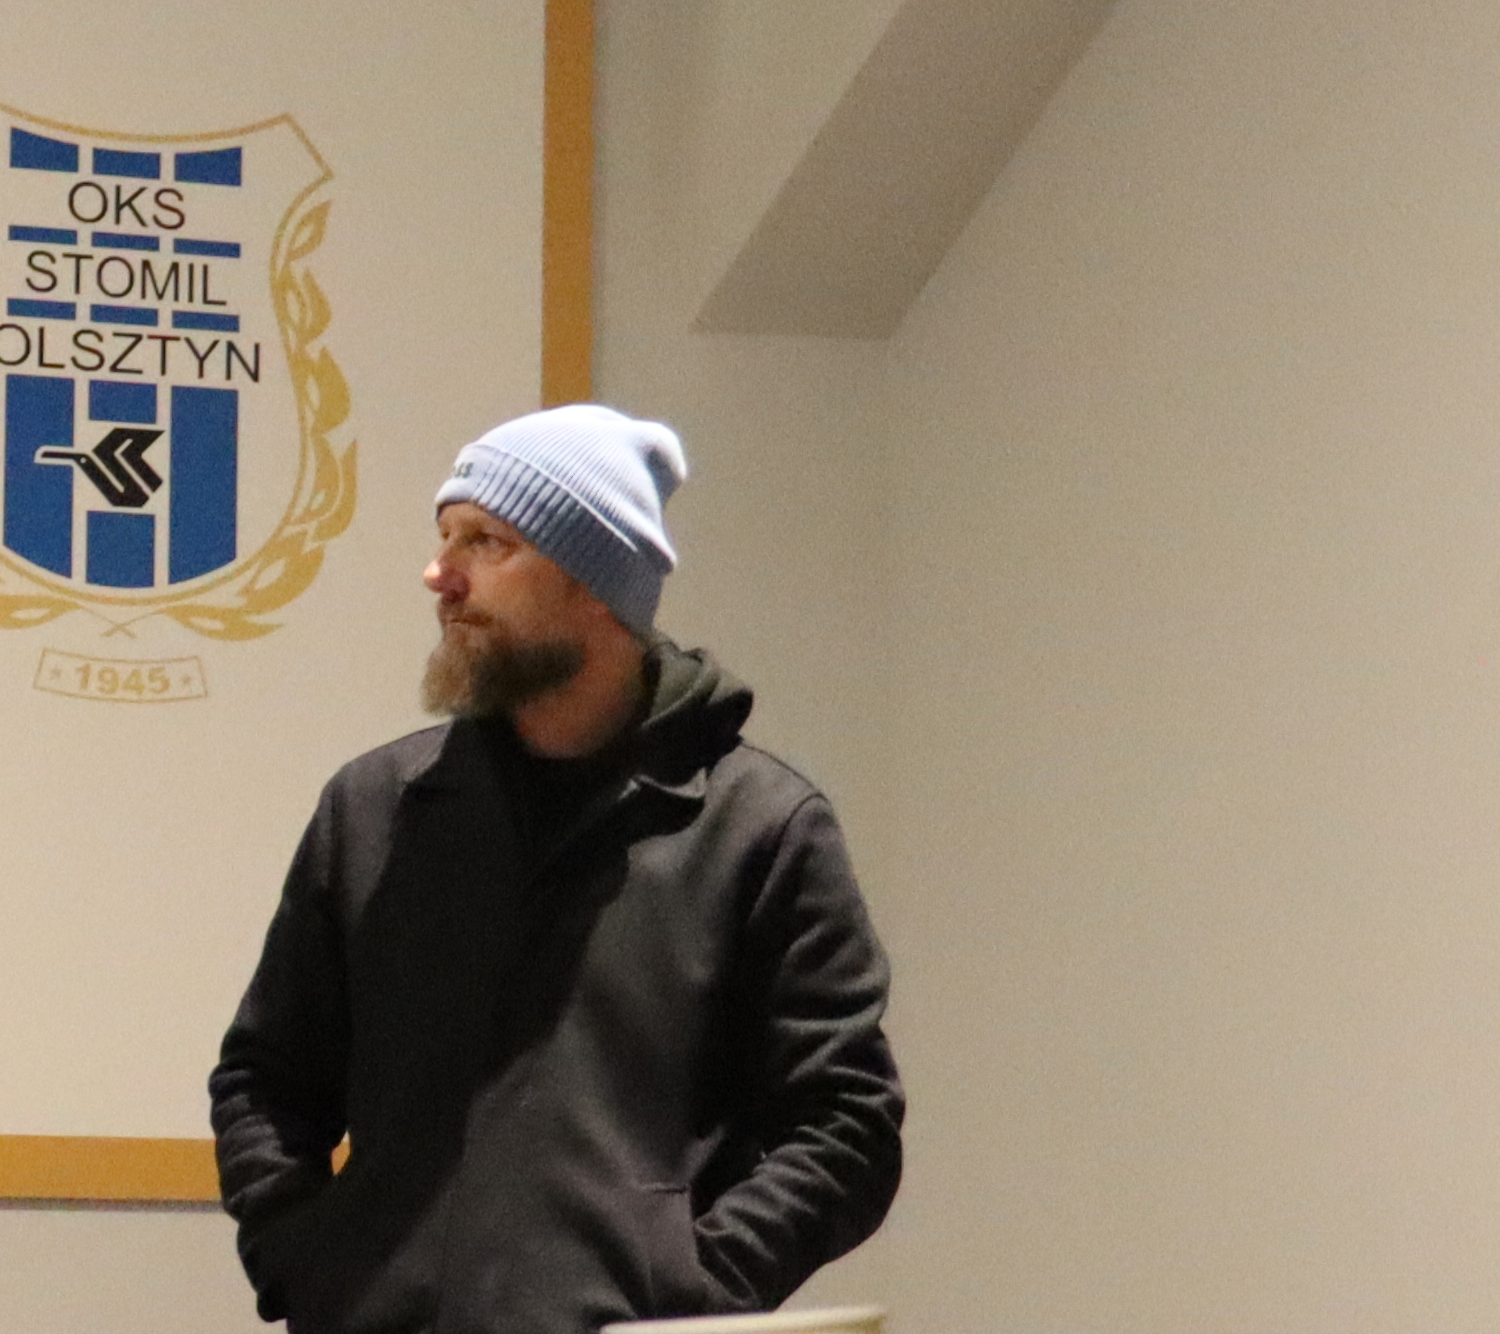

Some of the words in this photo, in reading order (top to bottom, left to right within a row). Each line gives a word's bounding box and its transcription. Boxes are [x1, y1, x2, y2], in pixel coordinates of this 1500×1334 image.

[69, 181, 186, 230] OKS
[25, 250, 227, 306] STOMIL
[75, 662, 171, 695] 1945
